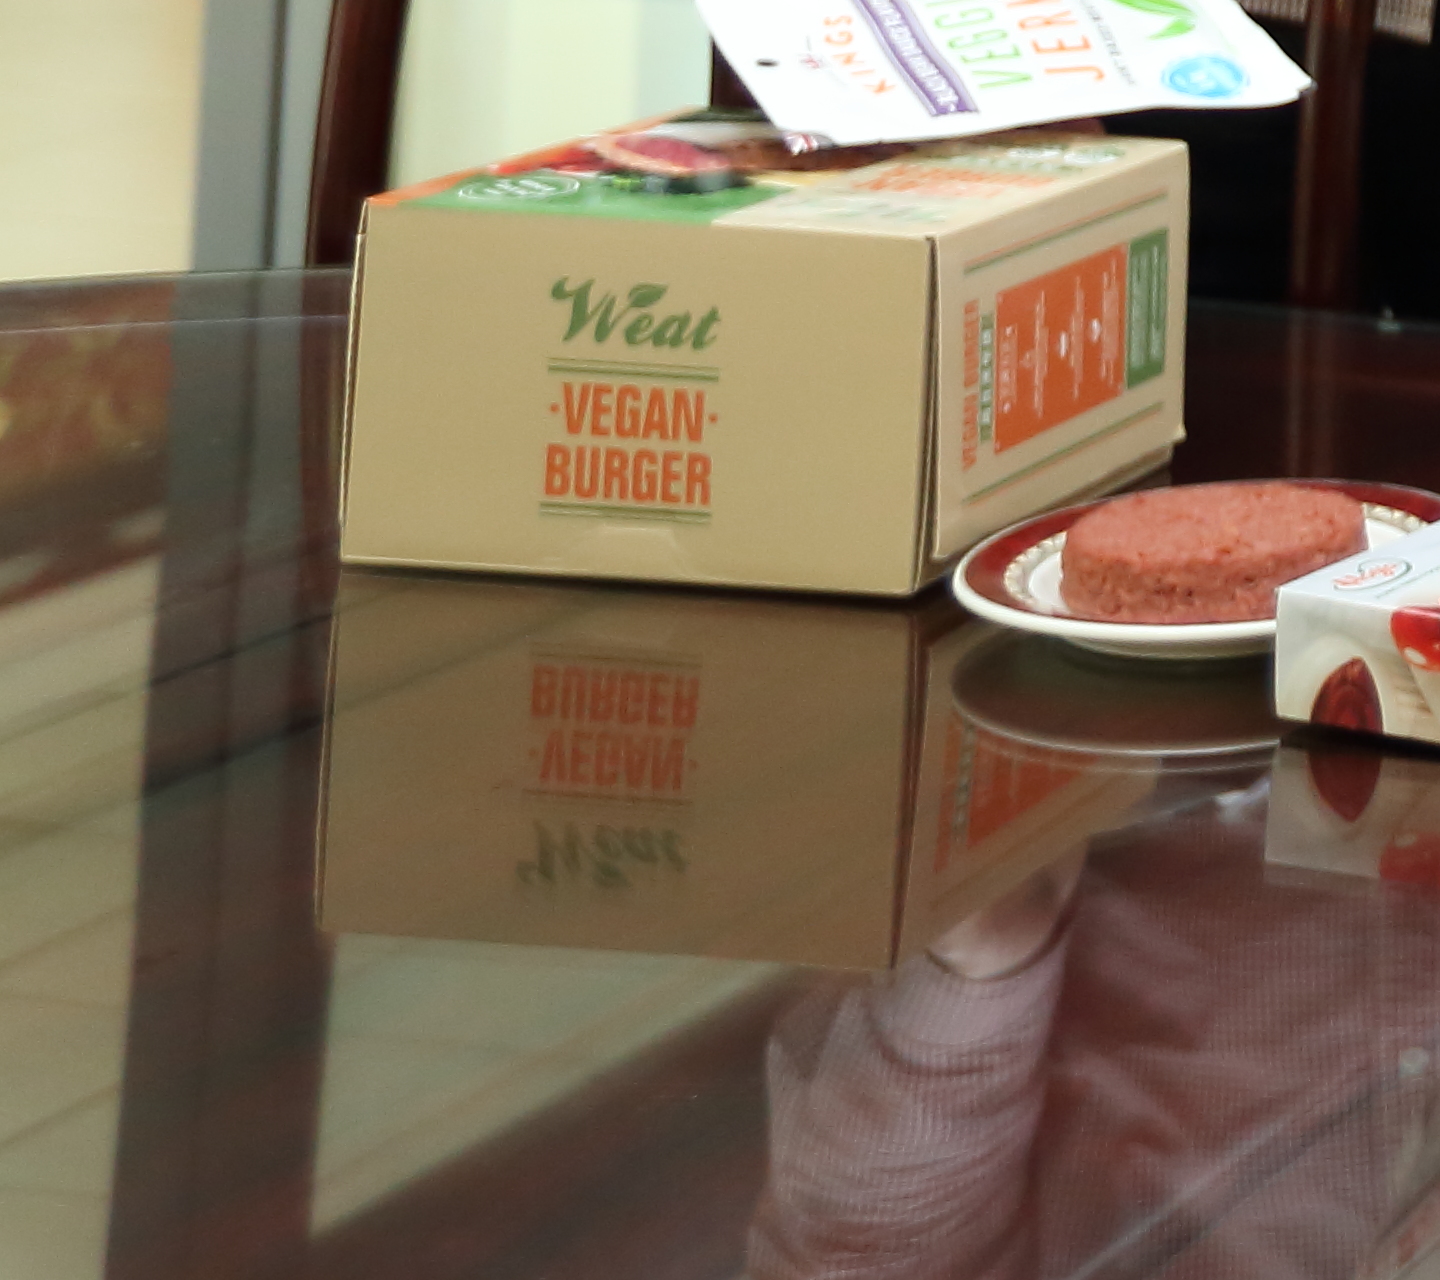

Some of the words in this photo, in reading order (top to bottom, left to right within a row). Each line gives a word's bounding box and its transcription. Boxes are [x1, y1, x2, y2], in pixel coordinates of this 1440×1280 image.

[823, 13, 897, 98] KINGS
[550, 274, 721, 351] Weat
[562, 382, 706, 444] VEGAN
[544, 442, 713, 507] BURGER
